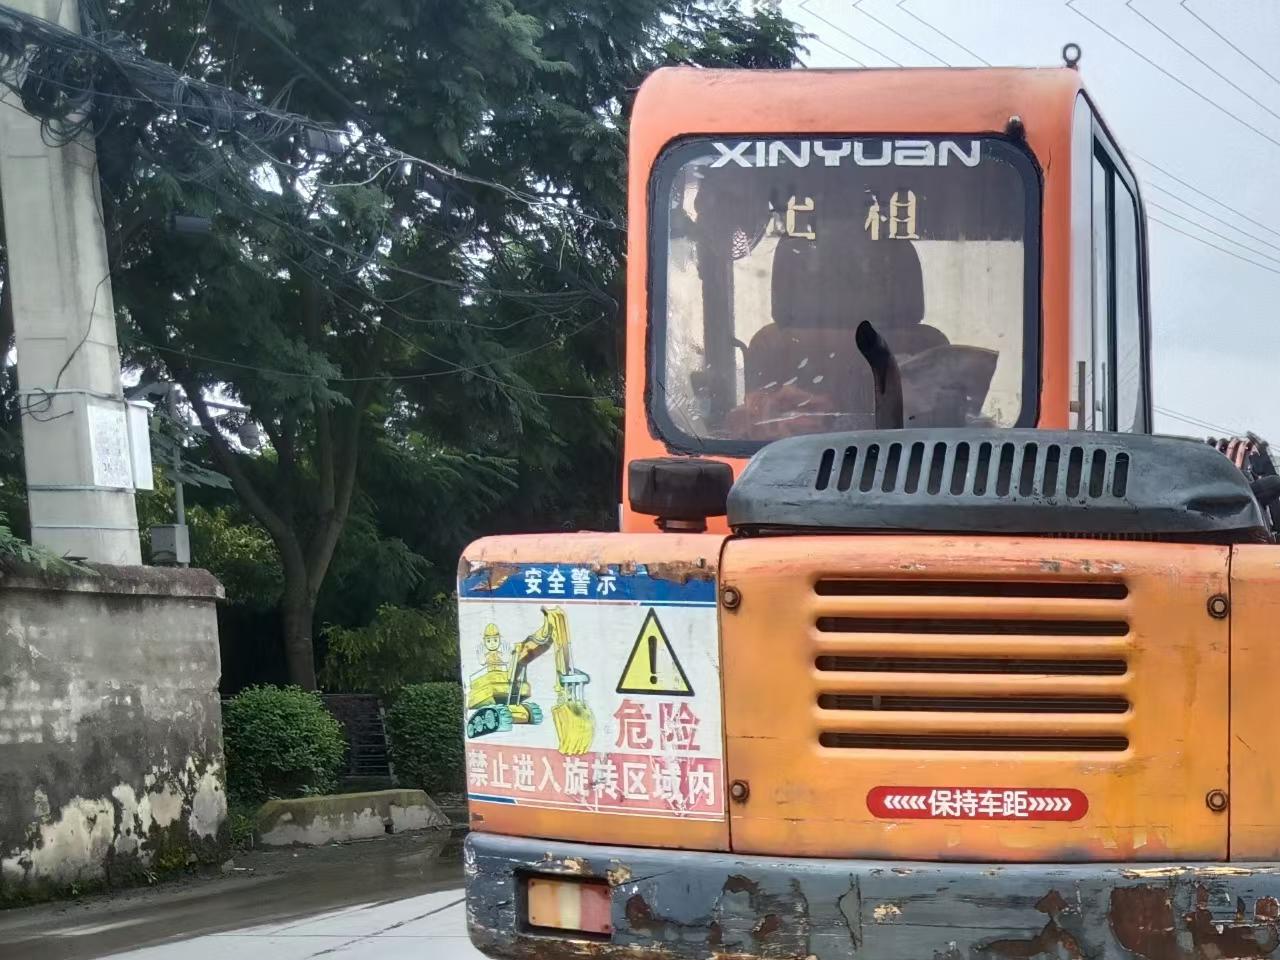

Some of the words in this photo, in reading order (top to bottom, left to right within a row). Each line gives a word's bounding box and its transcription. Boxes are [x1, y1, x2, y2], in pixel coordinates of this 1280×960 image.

[710, 140, 981, 168] XINYUAN
[524, 567, 617, 595] 安全警示
[613, 699, 701, 752] 危险
[467, 750, 714, 806] 禁止进入旋转区域内
[928, 789, 1029, 817] 保持车距
